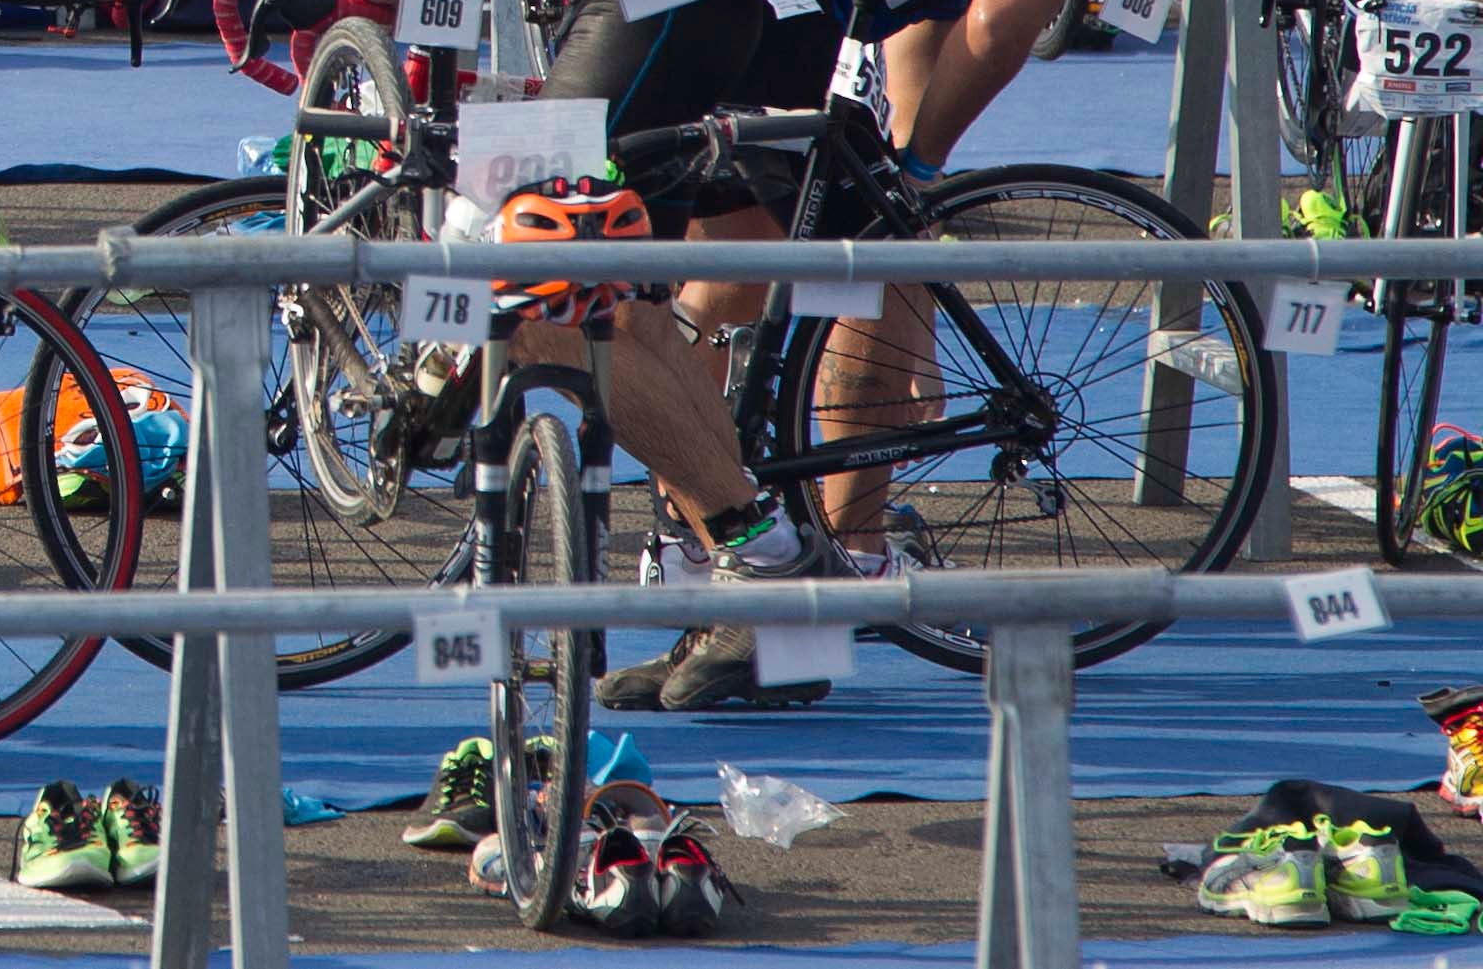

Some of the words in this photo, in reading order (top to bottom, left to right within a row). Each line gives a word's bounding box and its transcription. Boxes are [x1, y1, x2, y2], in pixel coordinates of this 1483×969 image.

[1384, 29, 1472, 77] 522
[425, 290, 470, 324] 718
[1286, 301, 1327, 335] 717
[1308, 591, 1360, 625] 844
[434, 634, 482, 669] 845
